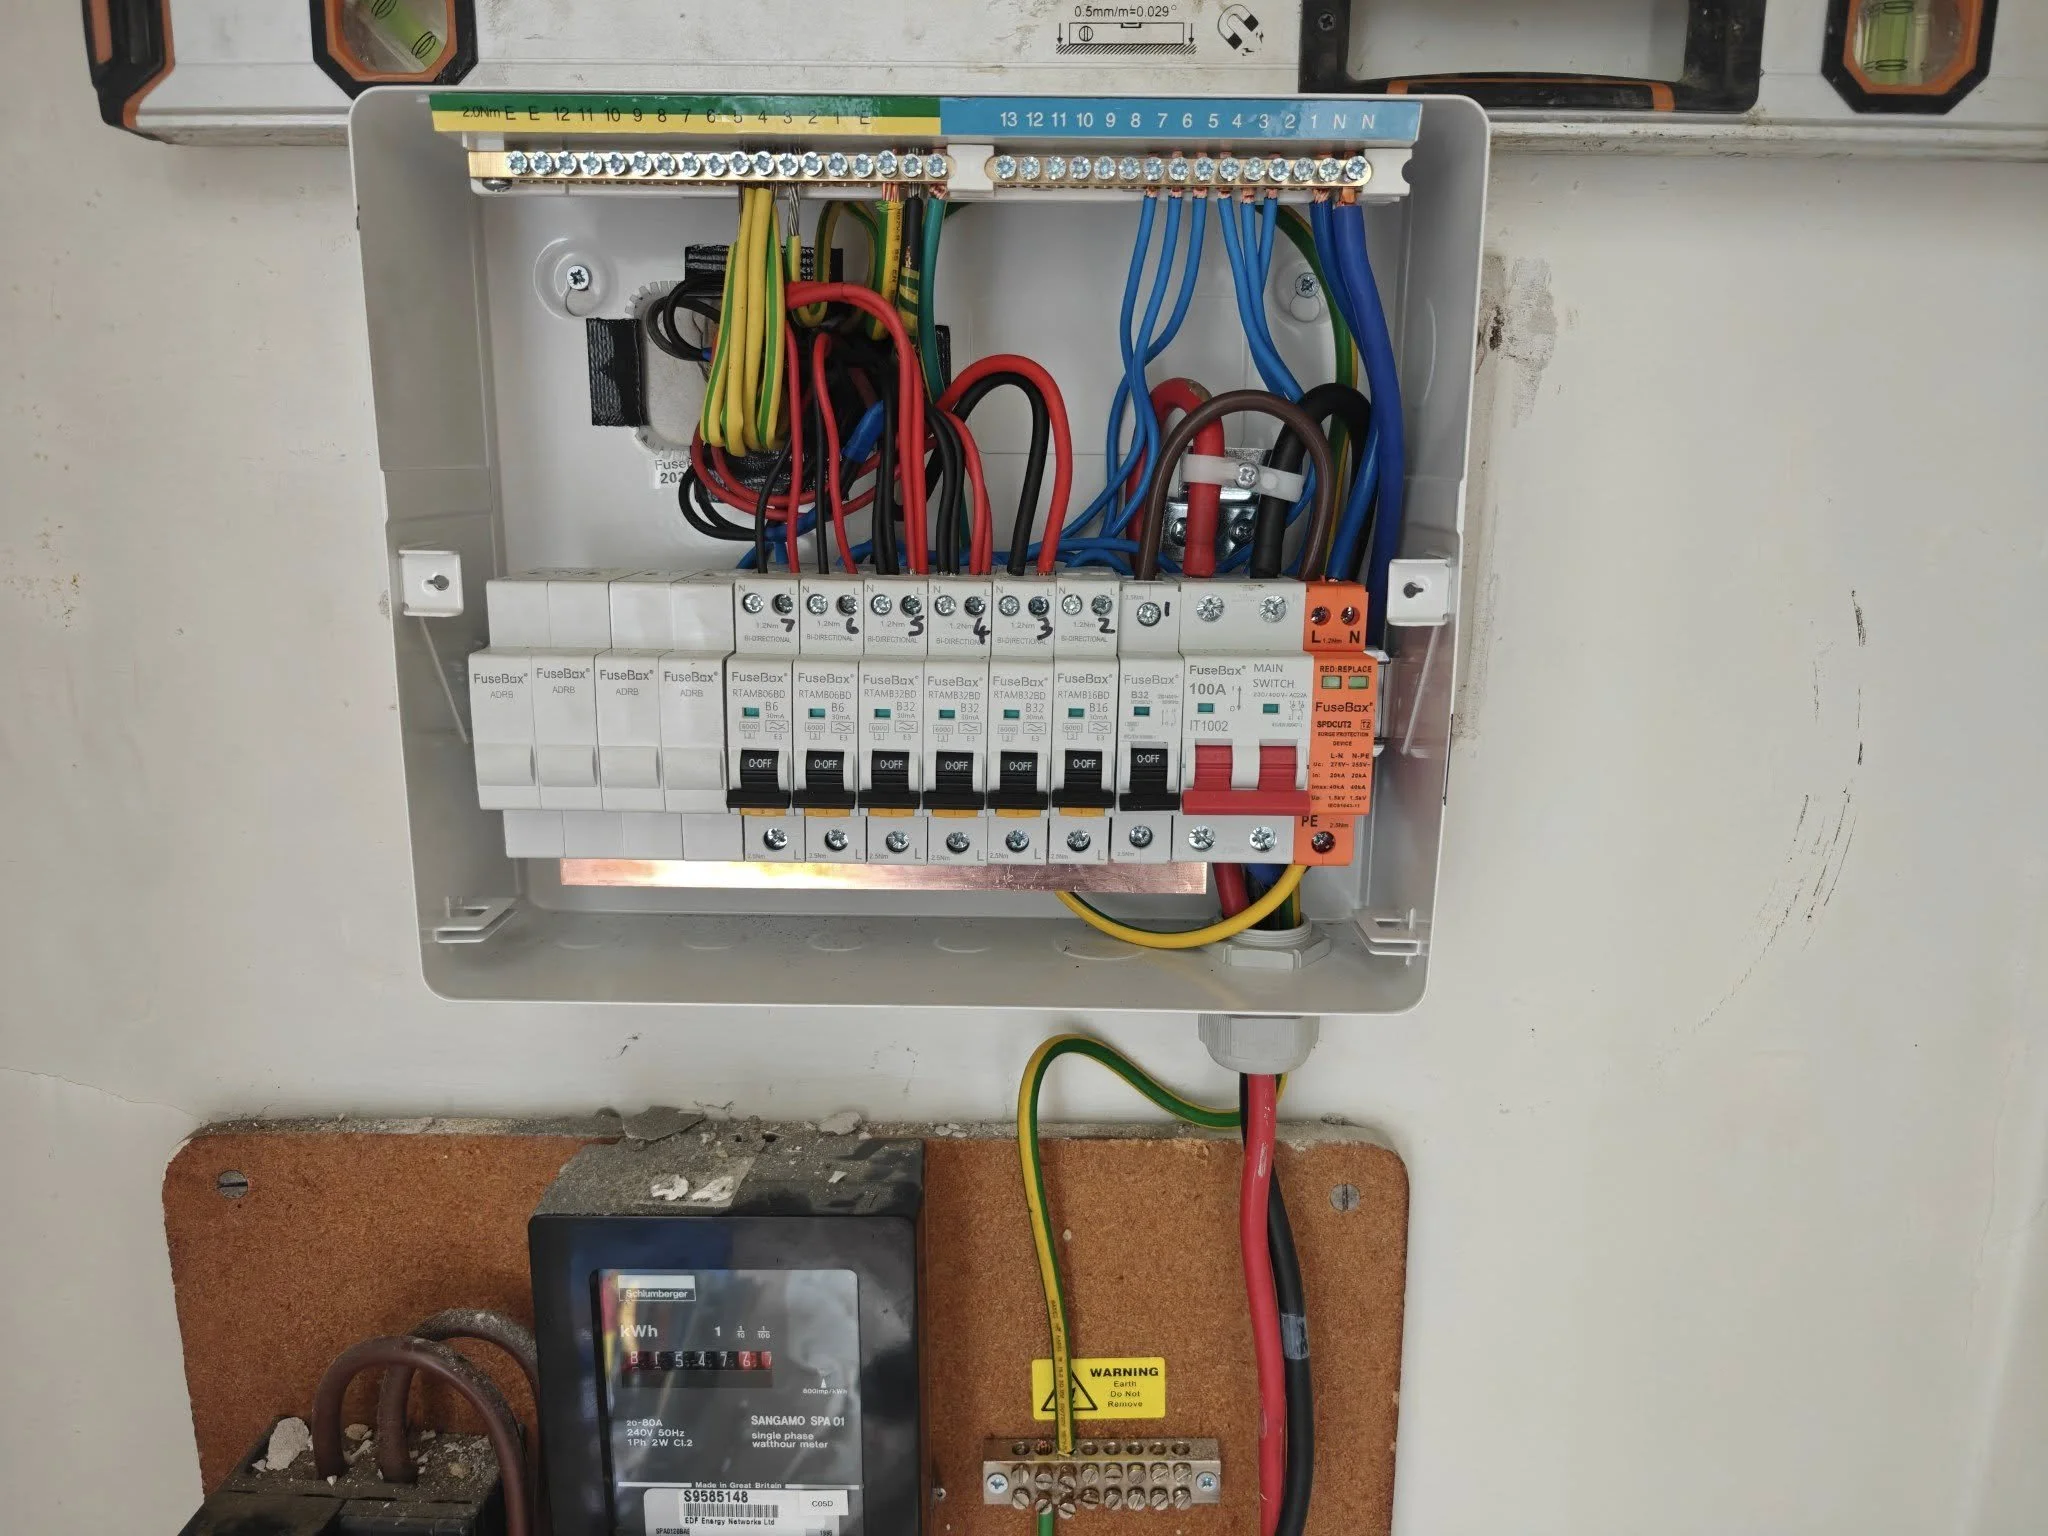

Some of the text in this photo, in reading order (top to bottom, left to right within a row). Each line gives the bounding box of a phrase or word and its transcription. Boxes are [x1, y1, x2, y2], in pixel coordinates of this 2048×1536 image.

[505, 106, 517, 121] E
[529, 106, 541, 121] E
[554, 107, 571, 122] 12
[579, 107, 593, 122] 11
[606, 107, 621, 122] 10
[633, 108, 643, 123] 9
[657, 108, 667, 123] 8
[681, 109, 691, 123] 7
[707, 109, 717, 124] 6
[758, 110, 768, 124] 4
[783, 110, 793, 124] 3
[808, 110, 818, 124] 2
[835, 110, 840, 124] 1
[1000, 112, 1376, 129] 13 12 11 10 9 8 7 6 5 4 3 2 1 N N
[655, 460, 691, 471] Fuse
[780, 618, 796, 633] 7
[846, 617, 860, 635] 6
[908, 615, 925, 637] 5
[973, 617, 991, 645] 4
[1037, 617, 1054, 641] 3
[1098, 617, 1116, 634] 2
[1311, 630, 1321, 644] L
[1349, 631, 1360, 644] N
[1253, 663, 1284, 673] MAIN
[1189, 683, 1227, 696] 100A
[1253, 679, 1295, 689] SWITCH
[1131, 691, 1149, 700] B32
[765, 702, 779, 712] B6
[831, 703, 845, 713] B6
[896, 702, 916, 712] B32
[961, 703, 980, 713] B32
[1025, 703, 1045, 713] B32
[1089, 703, 1108, 713] B16
[1190, 720, 1229, 732] IT1002
[1301, 815, 1319, 828] PE
[626, 1289, 688, 1300] Schlumberger
[620, 1325, 659, 1338] kWh
[1090, 1367, 1159, 1378] WARNING
[627, 1419, 663, 1427] 20-80A
[751, 1415, 846, 1427] SANGAMO SPA 01
[627, 1428, 685, 1438] 240V 50Hz
[752, 1432, 814, 1442] single phase
[628, 1439, 647, 1447] 1Ph
[652, 1439, 669, 1447] 2W
[752, 1440, 828, 1449] watthour meter
[684, 1490, 749, 1504] S9585148
[685, 1517, 775, 1527] EDF Energy Networks Ltd
